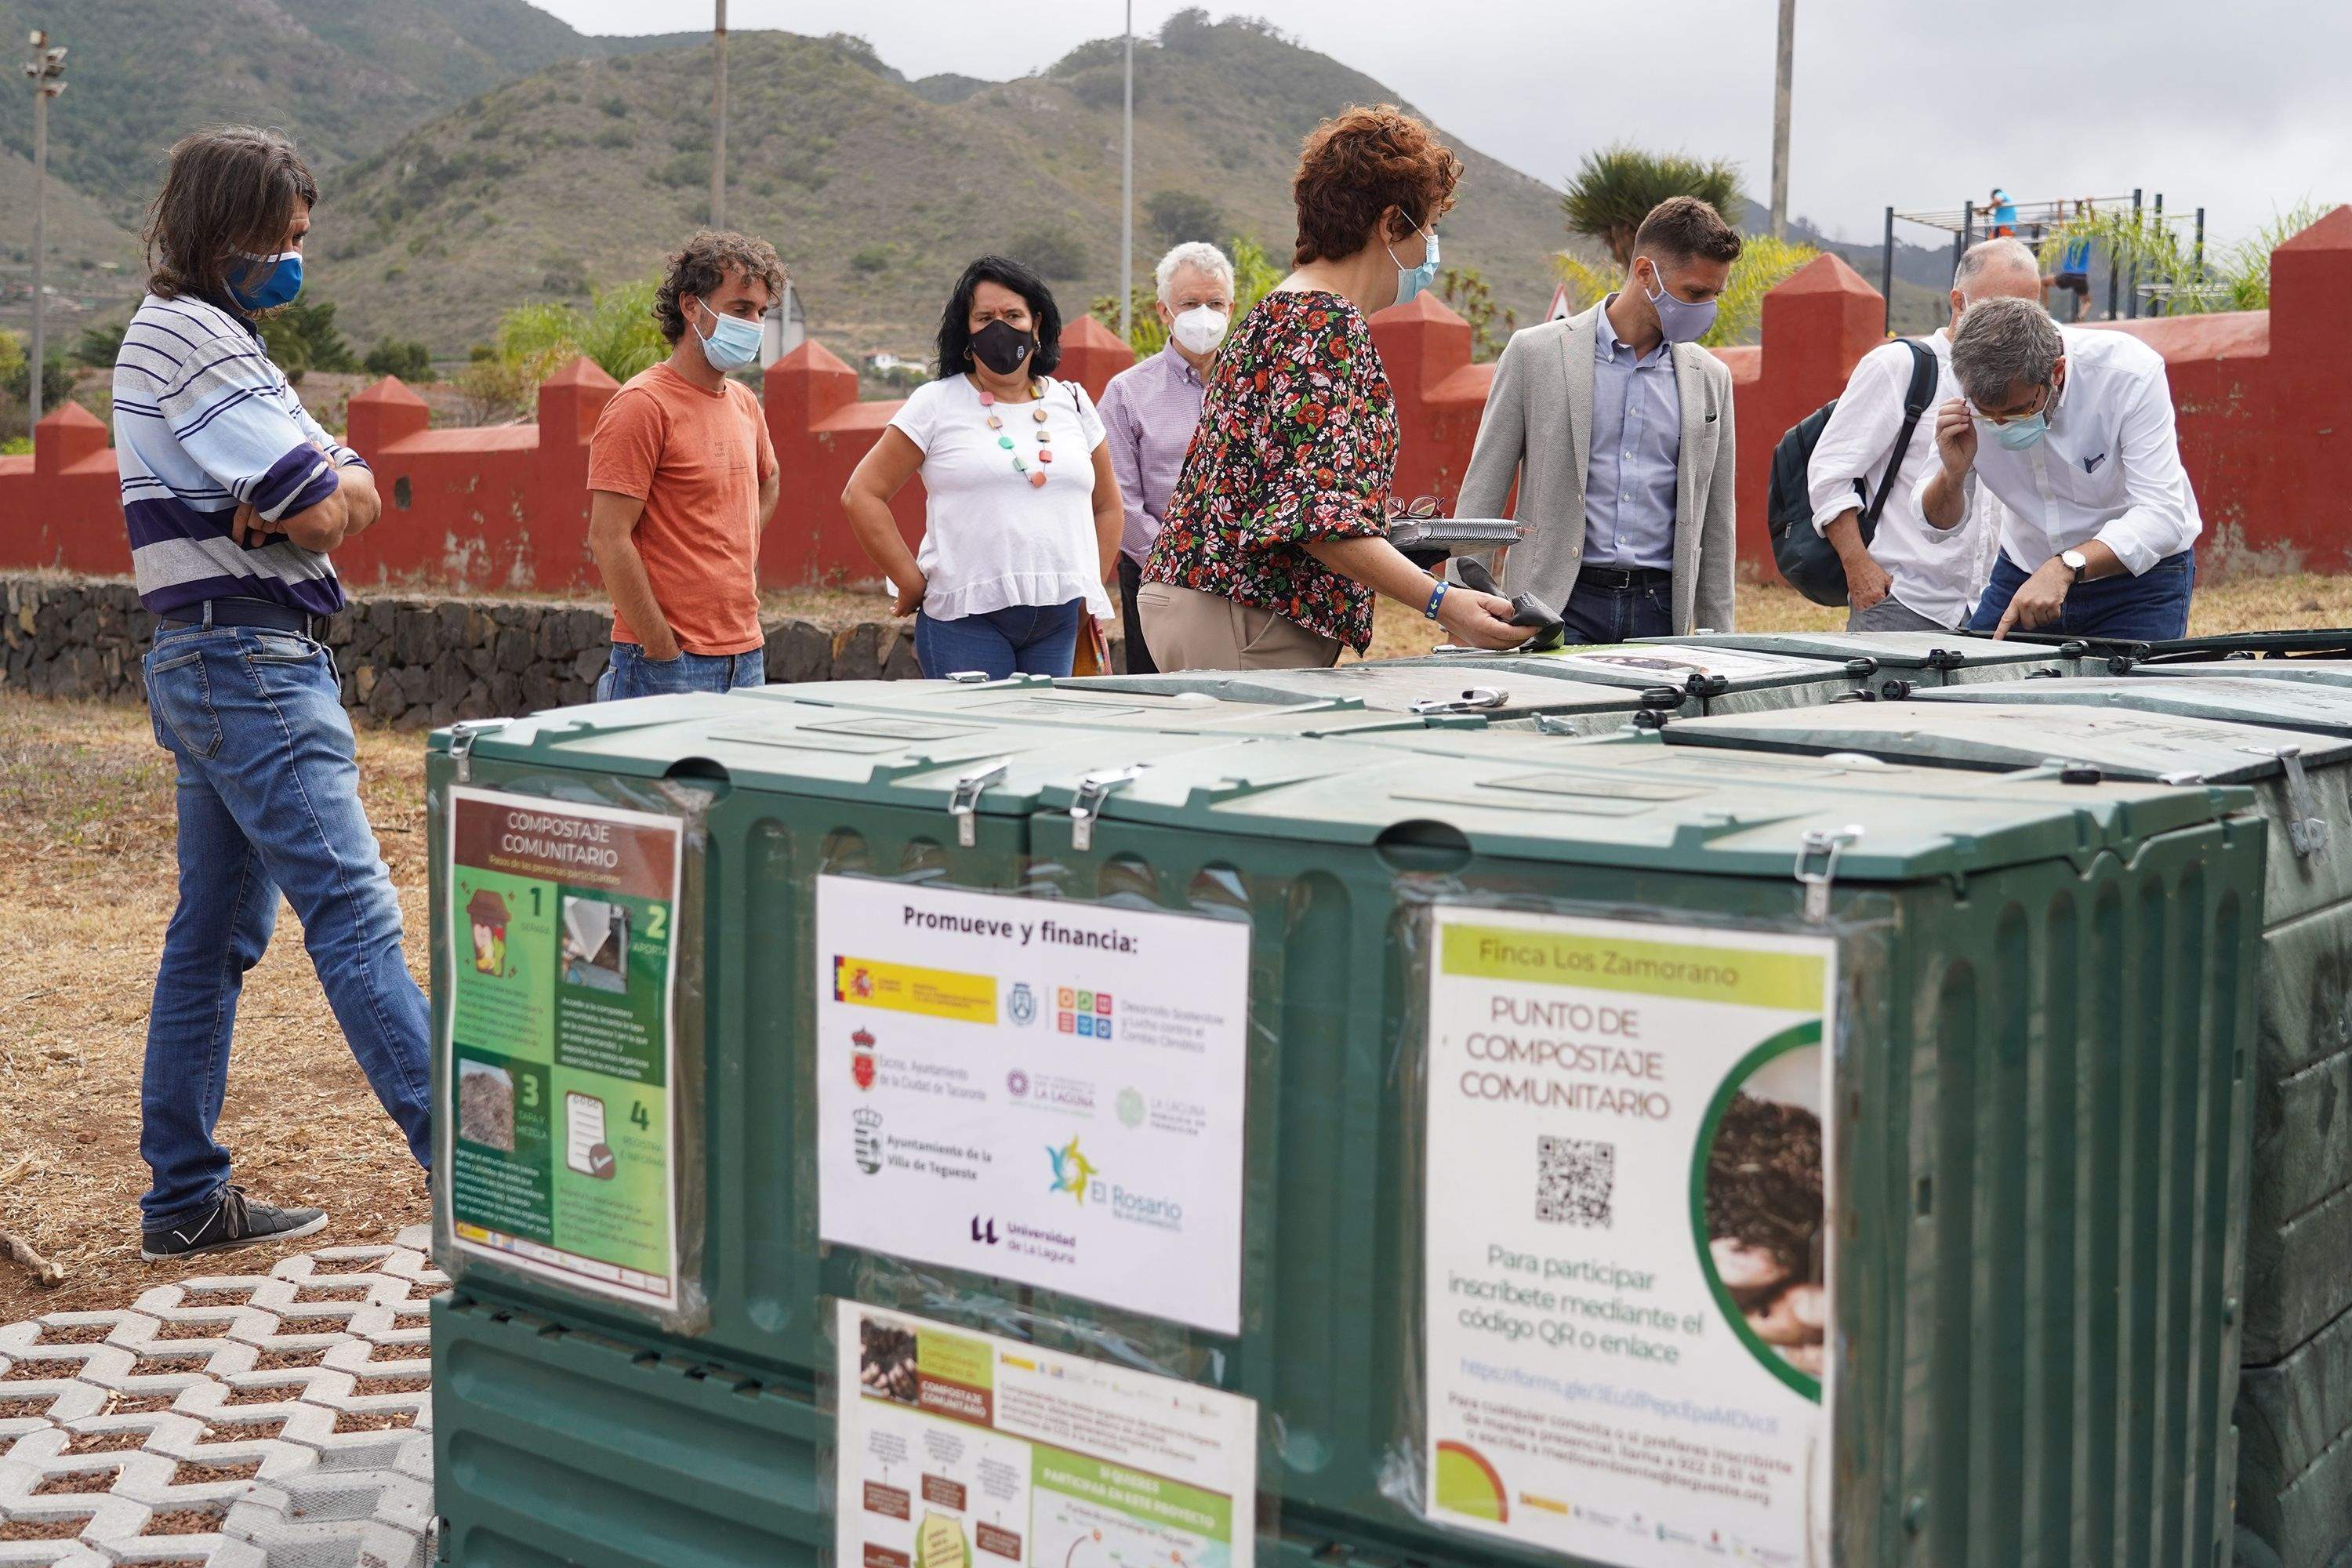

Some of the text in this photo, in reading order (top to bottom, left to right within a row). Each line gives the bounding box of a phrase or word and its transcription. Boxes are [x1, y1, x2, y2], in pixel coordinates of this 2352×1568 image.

[508, 811, 611, 844] COMPOSTAJE
[502, 833, 619, 869] COMUNITARIO
[533, 863, 566, 877] personas
[568, 869, 621, 886] participantes
[528, 887, 542, 917] 1
[647, 905, 667, 939] 2
[903, 905, 1138, 955] Promueve y financia:
[1479, 938, 1739, 986] Finca Los Zamorano
[1121, 1000, 1224, 1025] Desarrollo Sostenible
[1160, 1021, 1193, 1036] contra
[1196, 1026, 1203, 1037] el
[1491, 996, 1639, 1038] PUNTO DE
[912, 1059, 969, 1081] Ayuntamiento
[1465, 1032, 1664, 1080] COMPOSTAJE
[521, 1073, 539, 1108] 3
[880, 1073, 889, 1085] de
[892, 1075, 899, 1087] la
[902, 1074, 931, 1092] Ciudad
[935, 1080, 943, 1094] de
[1034, 1088, 1048, 1099] LA
[1051, 1089, 1096, 1110] LAGUNA
[1459, 1070, 1671, 1121] COMUNITARIO
[630, 1100, 649, 1131] 4
[887, 1134, 992, 1163] Ayuntamiento de la
[887, 1154, 978, 1179] Villa de Tegueste
[1091, 1179, 1182, 1221] El Rosario
[1008, 1221, 1076, 1247] Universidad
[1008, 1240, 1075, 1265] de La Laguna
[1487, 1243, 1656, 1291] Para participar
[1561, 1291, 1679, 1331] mediante
[1682, 1310, 1704, 1334] el
[1457, 1306, 1680, 1365] código QR o enlace
[920, 1380, 983, 1405] COMPOSTAJE
[921, 1391, 987, 1419] COMUNITARIO
[1449, 1390, 1793, 1473] Para cualquier consulta o si prefieres inscribirte
[1462, 1411, 1479, 1425] de
[1483, 1416, 1536, 1438] manera
[1619, 1444, 1661, 1465] llama
[1666, 1456, 1674, 1466] a
[1677, 1456, 1706, 1474] 922
[1112, 1468, 1160, 1494] QUIERES
[1466, 1428, 1475, 1440] o
[1478, 1430, 1526, 1452] escribe
[1541, 1446, 1770, 1508] medioambiente@tegueste.org
[1042, 1466, 1106, 1497] PARTICIPAR
[1108, 1486, 1123, 1502] EN
[1124, 1490, 1152, 1512] ESTE
[1153, 1499, 1215, 1530] PROYECTO
